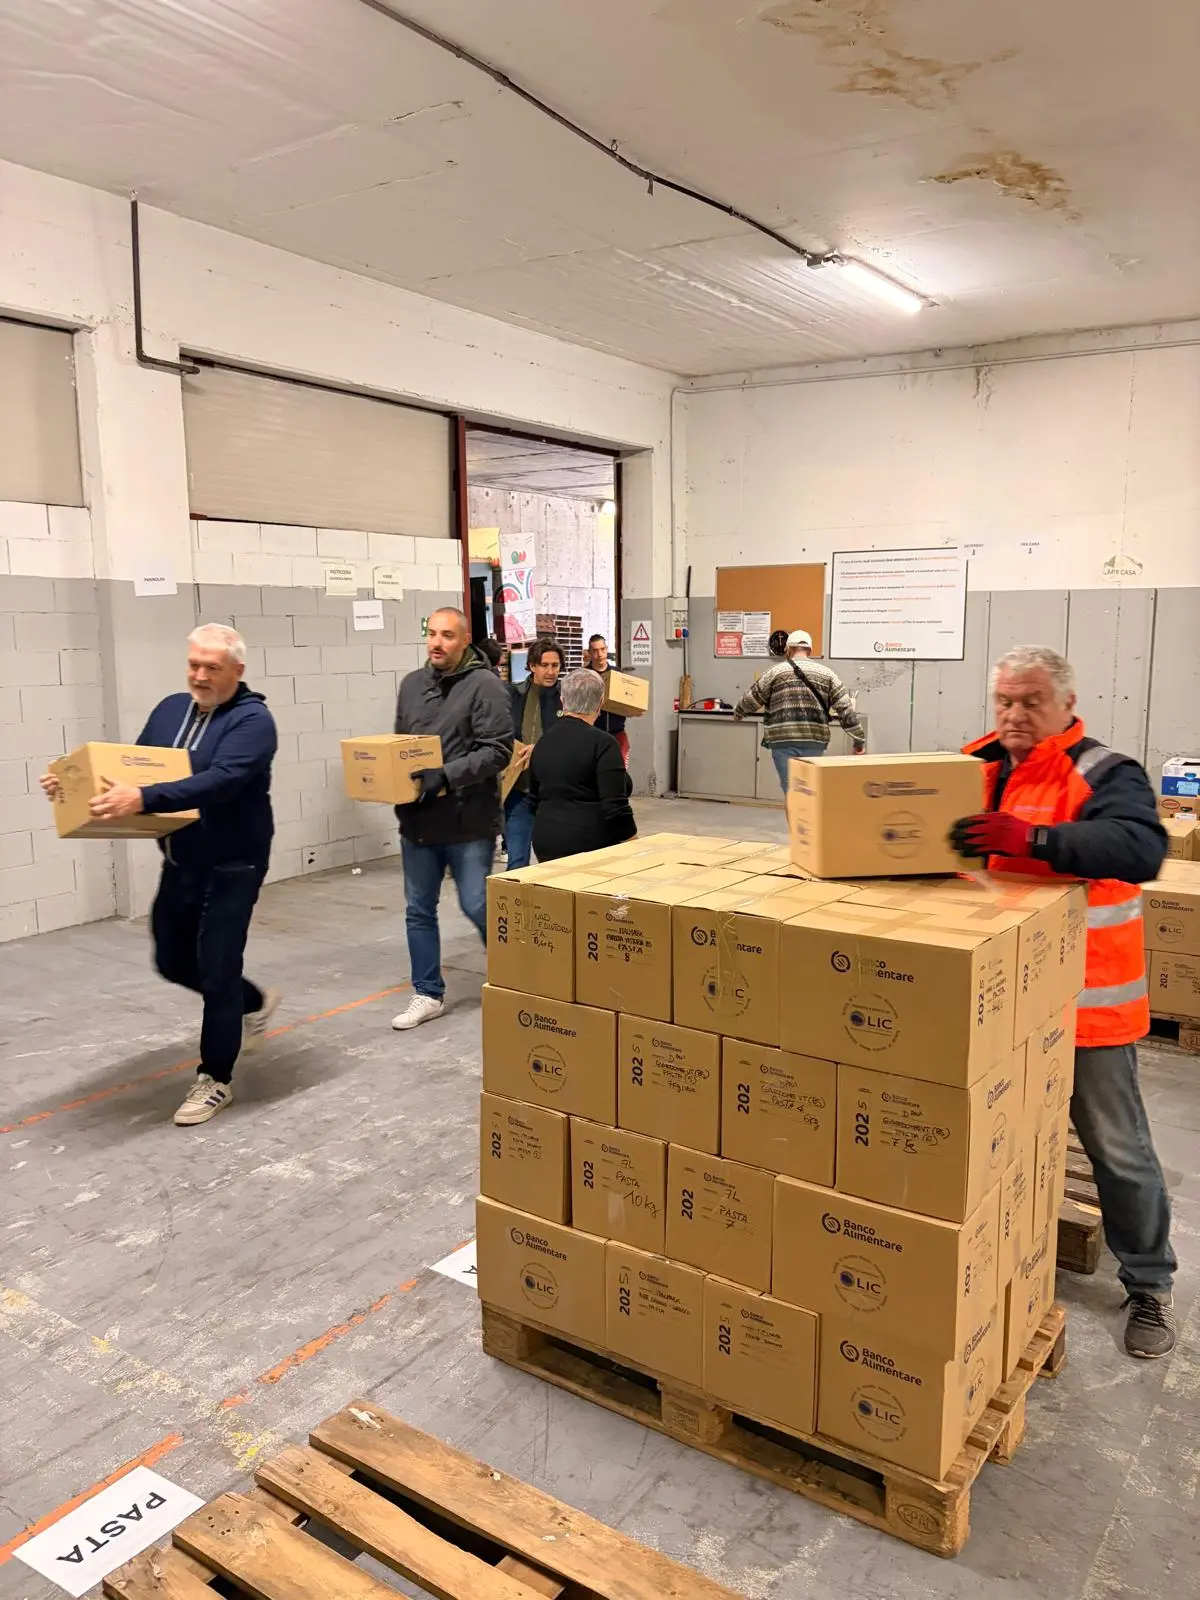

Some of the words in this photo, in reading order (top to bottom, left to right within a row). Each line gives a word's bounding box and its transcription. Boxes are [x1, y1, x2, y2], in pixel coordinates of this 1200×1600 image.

[588, 932, 598, 962] 202
[618, 943, 643, 954] PASTA
[534, 1013, 557, 1026] Banco
[868, 1015, 893, 1030] LIC
[533, 1021, 577, 1038] Alimentare
[544, 1063, 562, 1076] LIC
[737, 1083, 750, 1115] 202
[583, 1160, 594, 1190] 202
[615, 1171, 641, 1188] PASTA
[681, 1189, 694, 1221] 202
[719, 1205, 748, 1224] PASTA
[843, 1219, 876, 1236] Banco
[526, 1232, 549, 1247] Banco
[842, 1229, 904, 1253] Alimentare
[525, 1240, 568, 1261] Alimentare
[536, 1282, 554, 1296] LIC
[856, 1277, 881, 1295] LIC
[862, 1347, 895, 1367] Banco
[861, 1356, 923, 1386] Alimentare
[875, 1407, 901, 1425] LIC
[56, 1491, 167, 1564] PASTA
